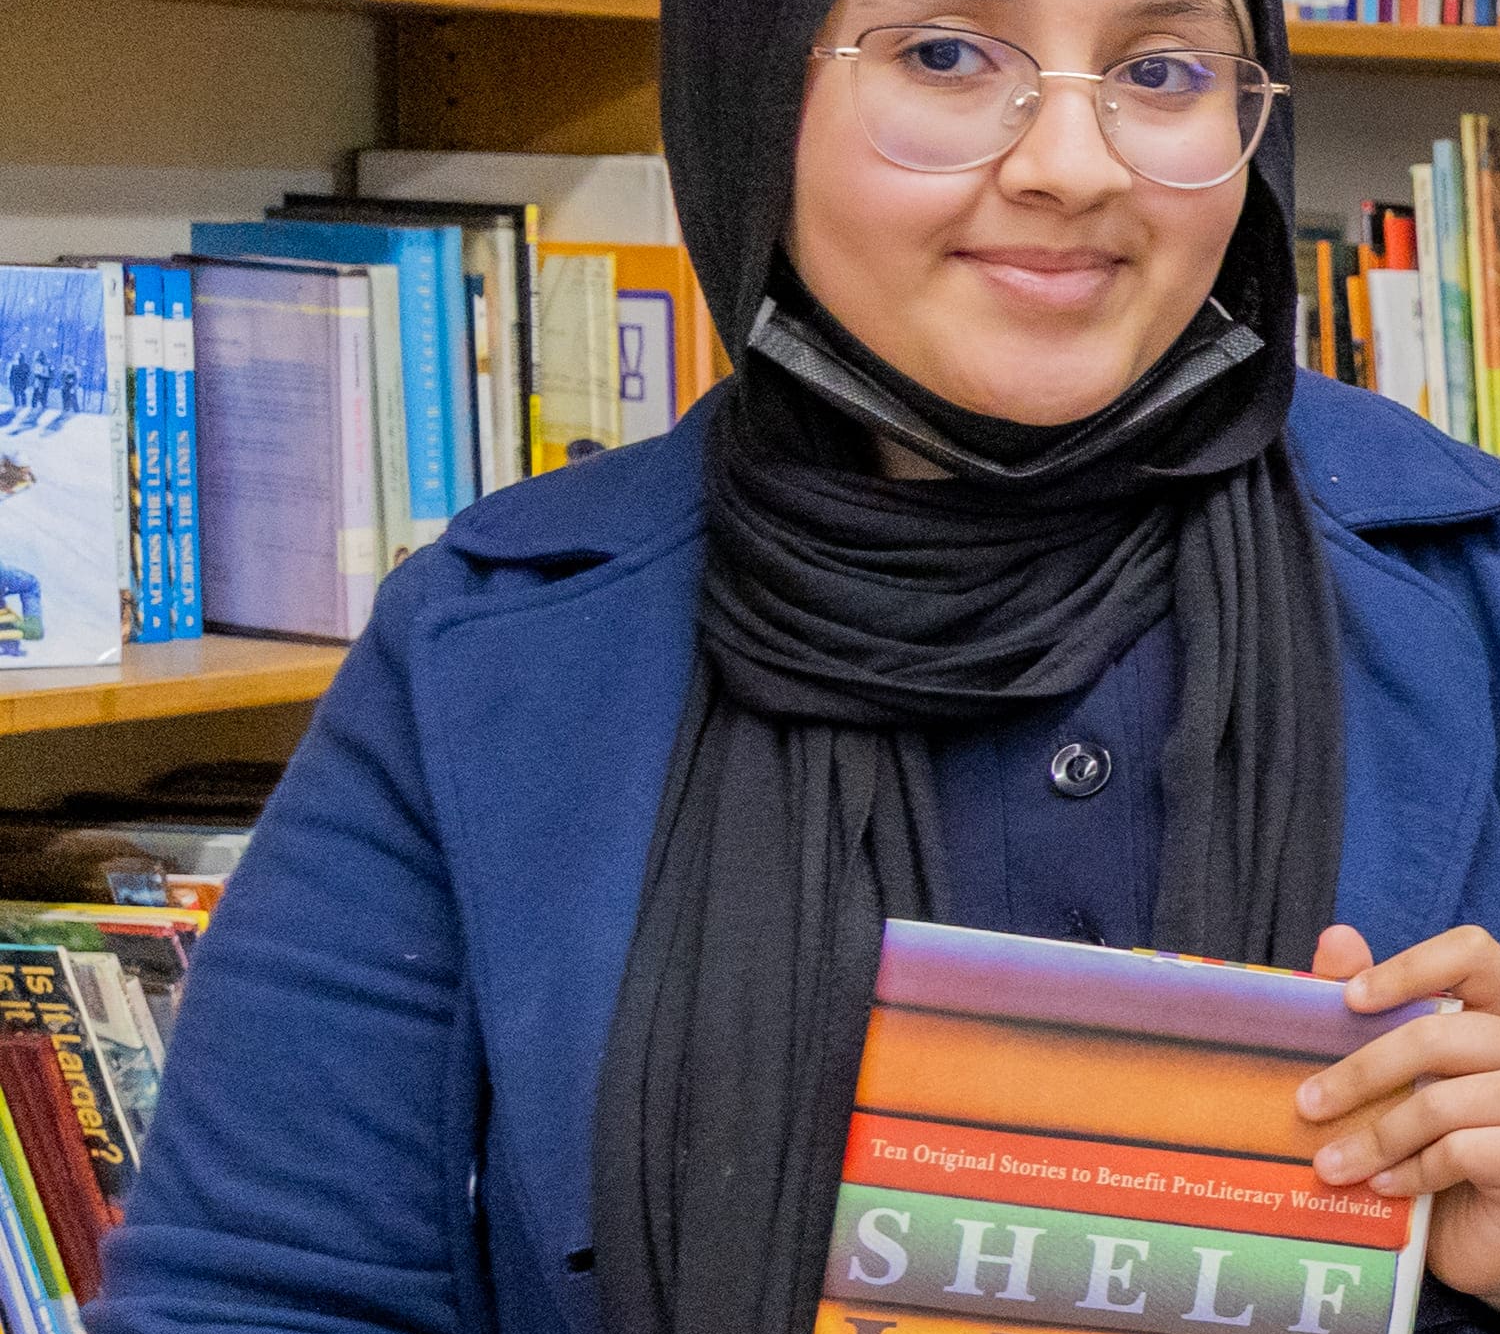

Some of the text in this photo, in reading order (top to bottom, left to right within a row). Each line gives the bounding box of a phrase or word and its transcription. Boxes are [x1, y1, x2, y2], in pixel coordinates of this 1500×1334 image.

[146, 430, 163, 606] ACROSS THE LINES
[176, 430, 196, 606] ACROSS THE LINES
[22, 966, 54, 995] Is
[37, 1002, 73, 1025] It
[870, 1138, 1394, 1220] Ten Original Stories to Benefit ProLiteracy Worldwide
